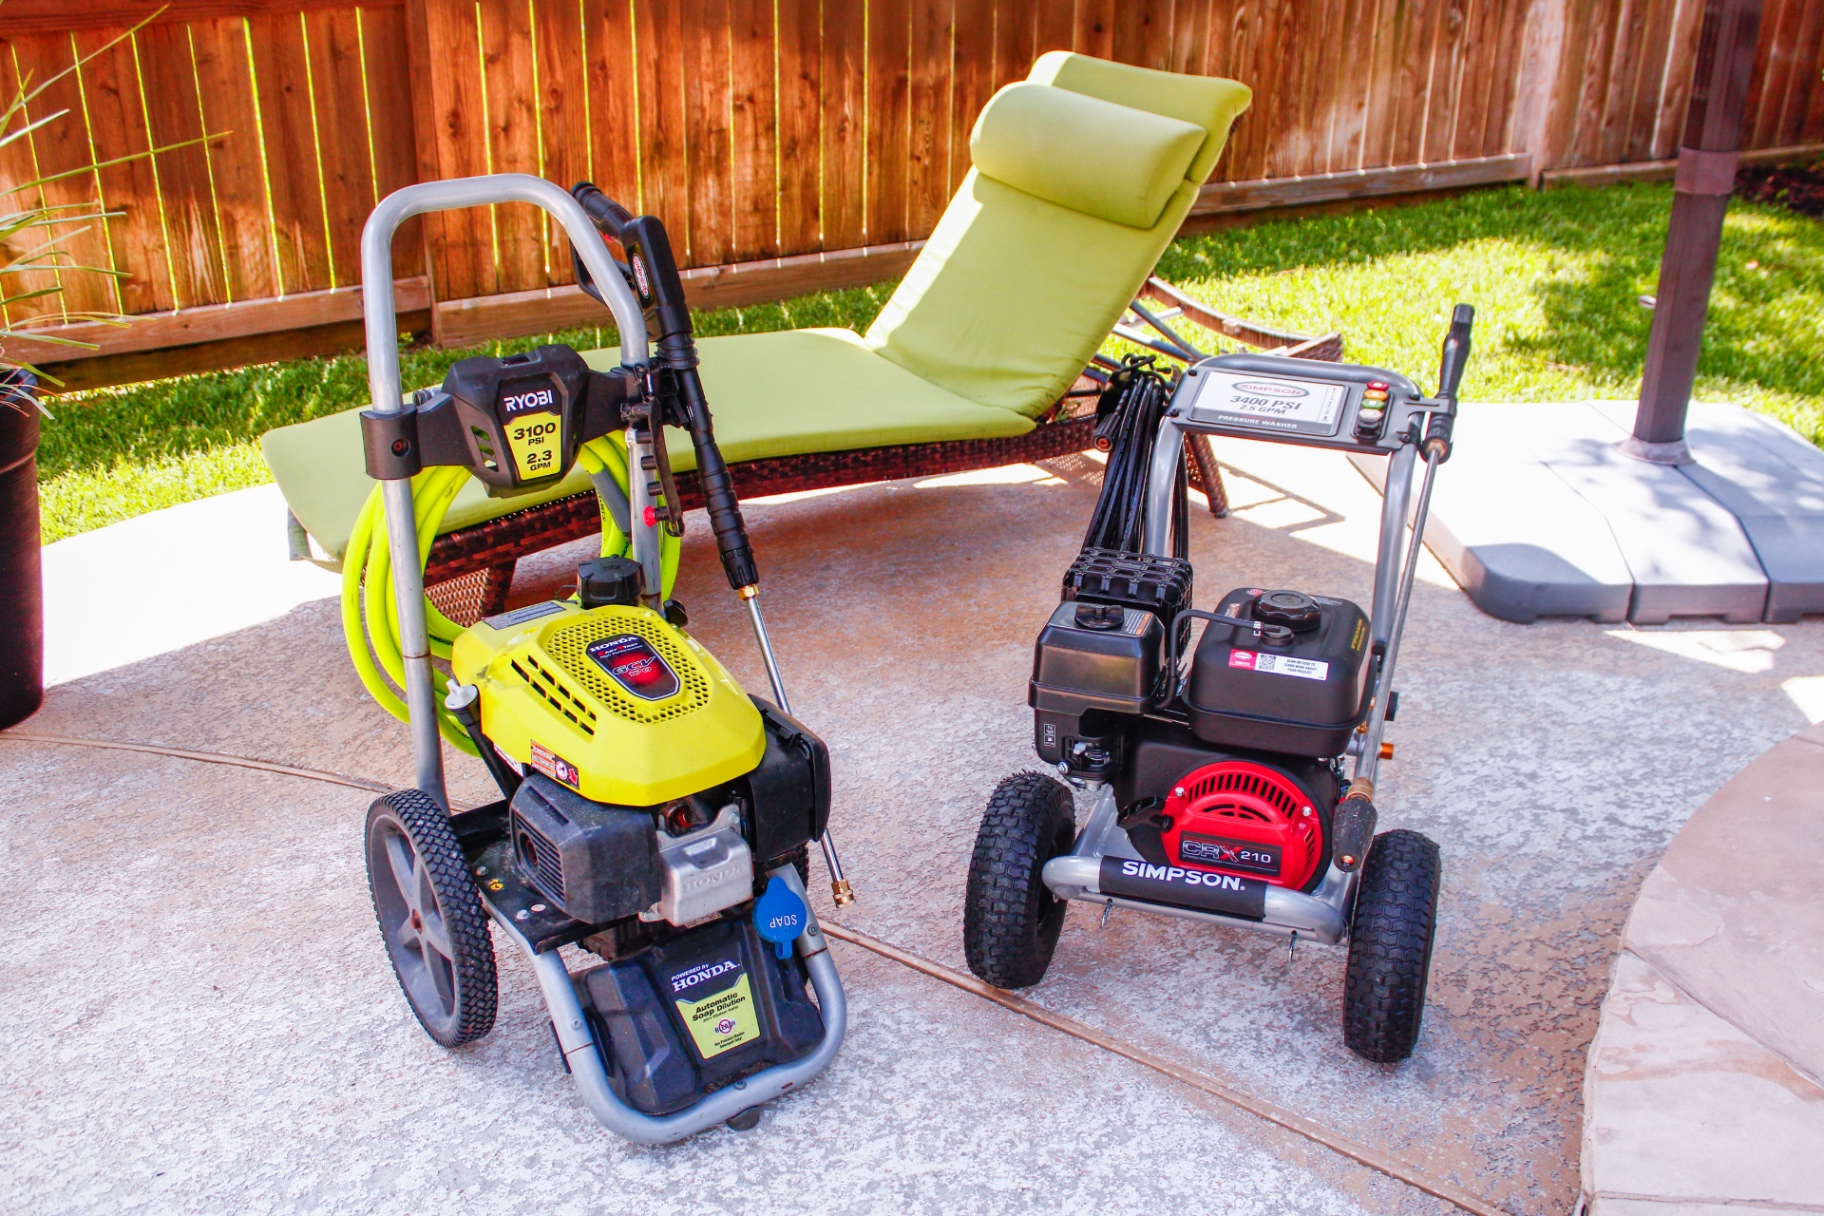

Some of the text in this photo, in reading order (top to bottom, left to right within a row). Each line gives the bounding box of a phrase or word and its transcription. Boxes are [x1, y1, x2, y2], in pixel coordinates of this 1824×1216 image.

[1241, 384, 1302, 396] SIMPSON
[503, 389, 553, 412] RYOBI
[1229, 395, 1302, 411] 3400 PSI
[1239, 404, 1286, 415] 2.5 GPM
[1218, 414, 1298, 429] PRESSURE WASHER
[513, 422, 556, 440] 3100
[528, 436, 545, 446] PSI
[526, 450, 552, 464] 2.3
[530, 461, 551, 471] GPM
[589, 636, 639, 652] HONDA
[612, 656, 656, 675] GCV
[1182, 840, 1243, 862] CRX
[1240, 850, 1272, 864] 210
[682, 864, 744, 893] HONDA
[769, 914, 798, 929] SOAP
[671, 966, 701, 981] POWERED
[672, 960, 738, 992] HONDA
[692, 996, 746, 1021] Soap Dilution
[696, 992, 739, 1014] Automatic
